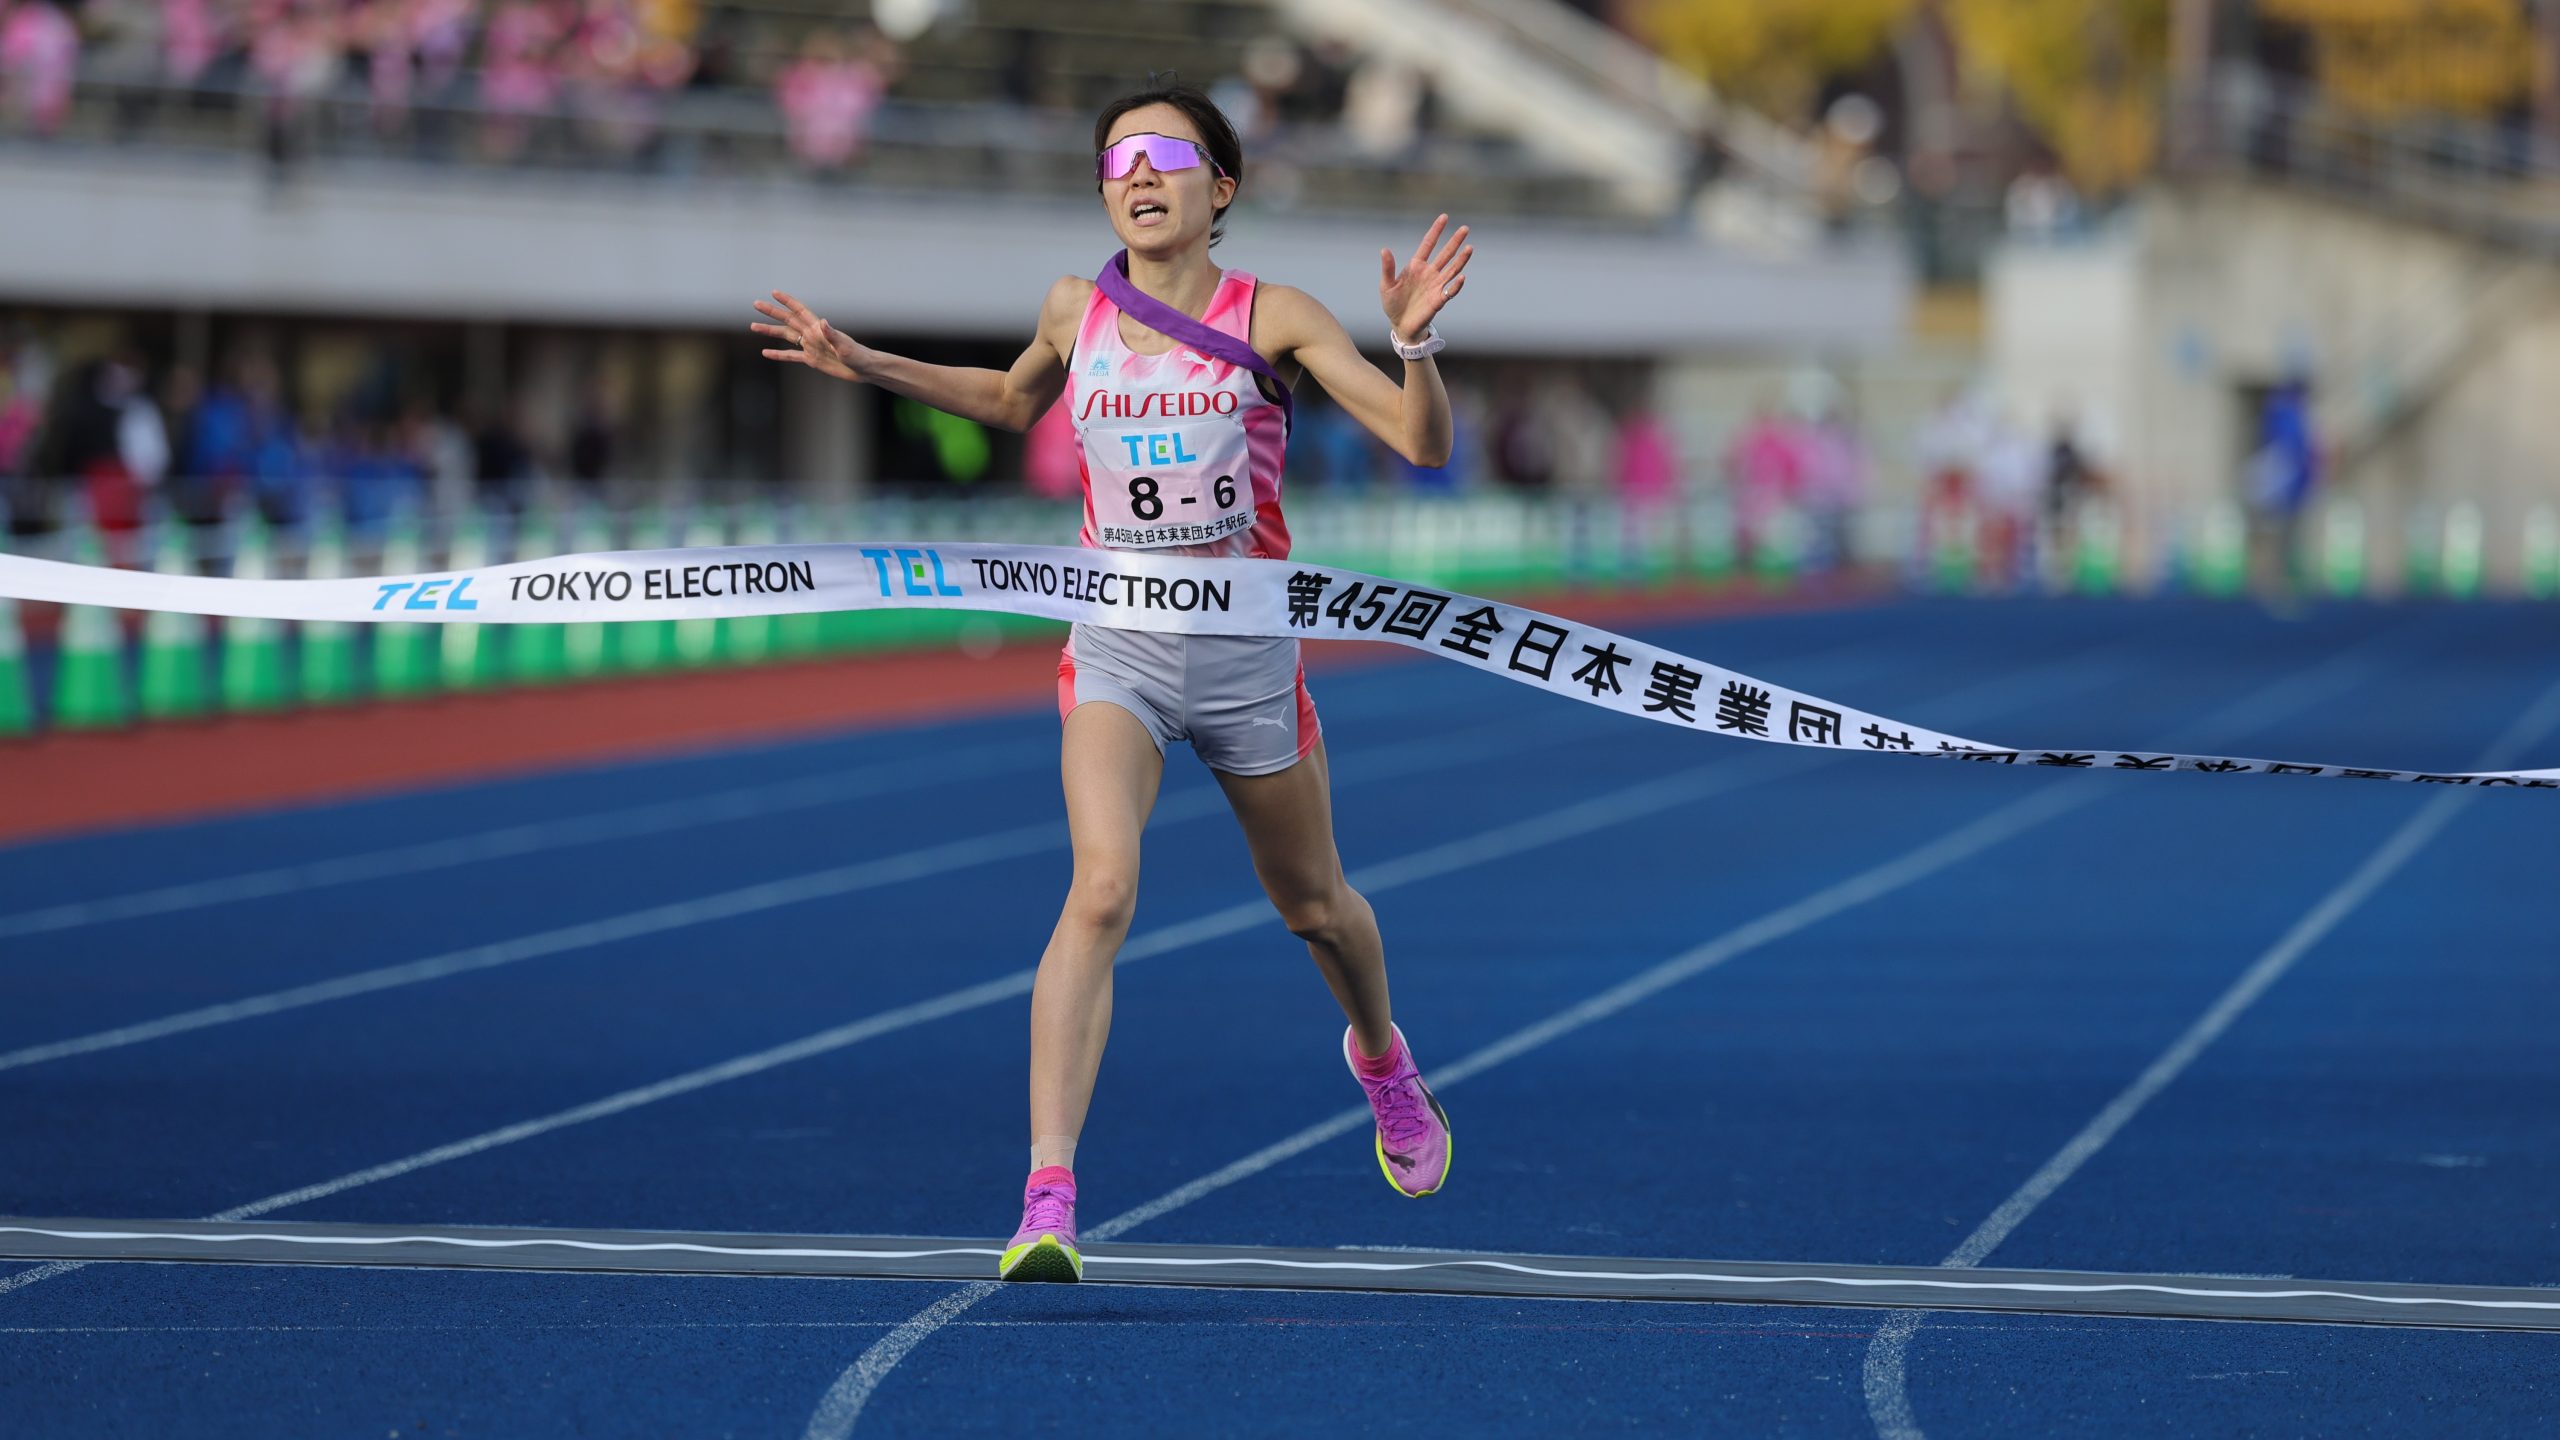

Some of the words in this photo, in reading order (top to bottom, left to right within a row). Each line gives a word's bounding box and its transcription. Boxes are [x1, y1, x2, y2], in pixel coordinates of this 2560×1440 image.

[1080, 389, 1238, 420] SHISEIDO
[1121, 432, 1197, 466] TEL
[1104, 512, 1247, 543] 第45回全日本実業団女子駅伝
[372, 577, 479, 610] TEL
[510, 571, 632, 602] TOKYO
[644, 561, 816, 601] ELECTRON
[859, 548, 964, 597] TEL
[971, 558, 1057, 596] TOKYO
[1063, 567, 1231, 612] ELECTRON
